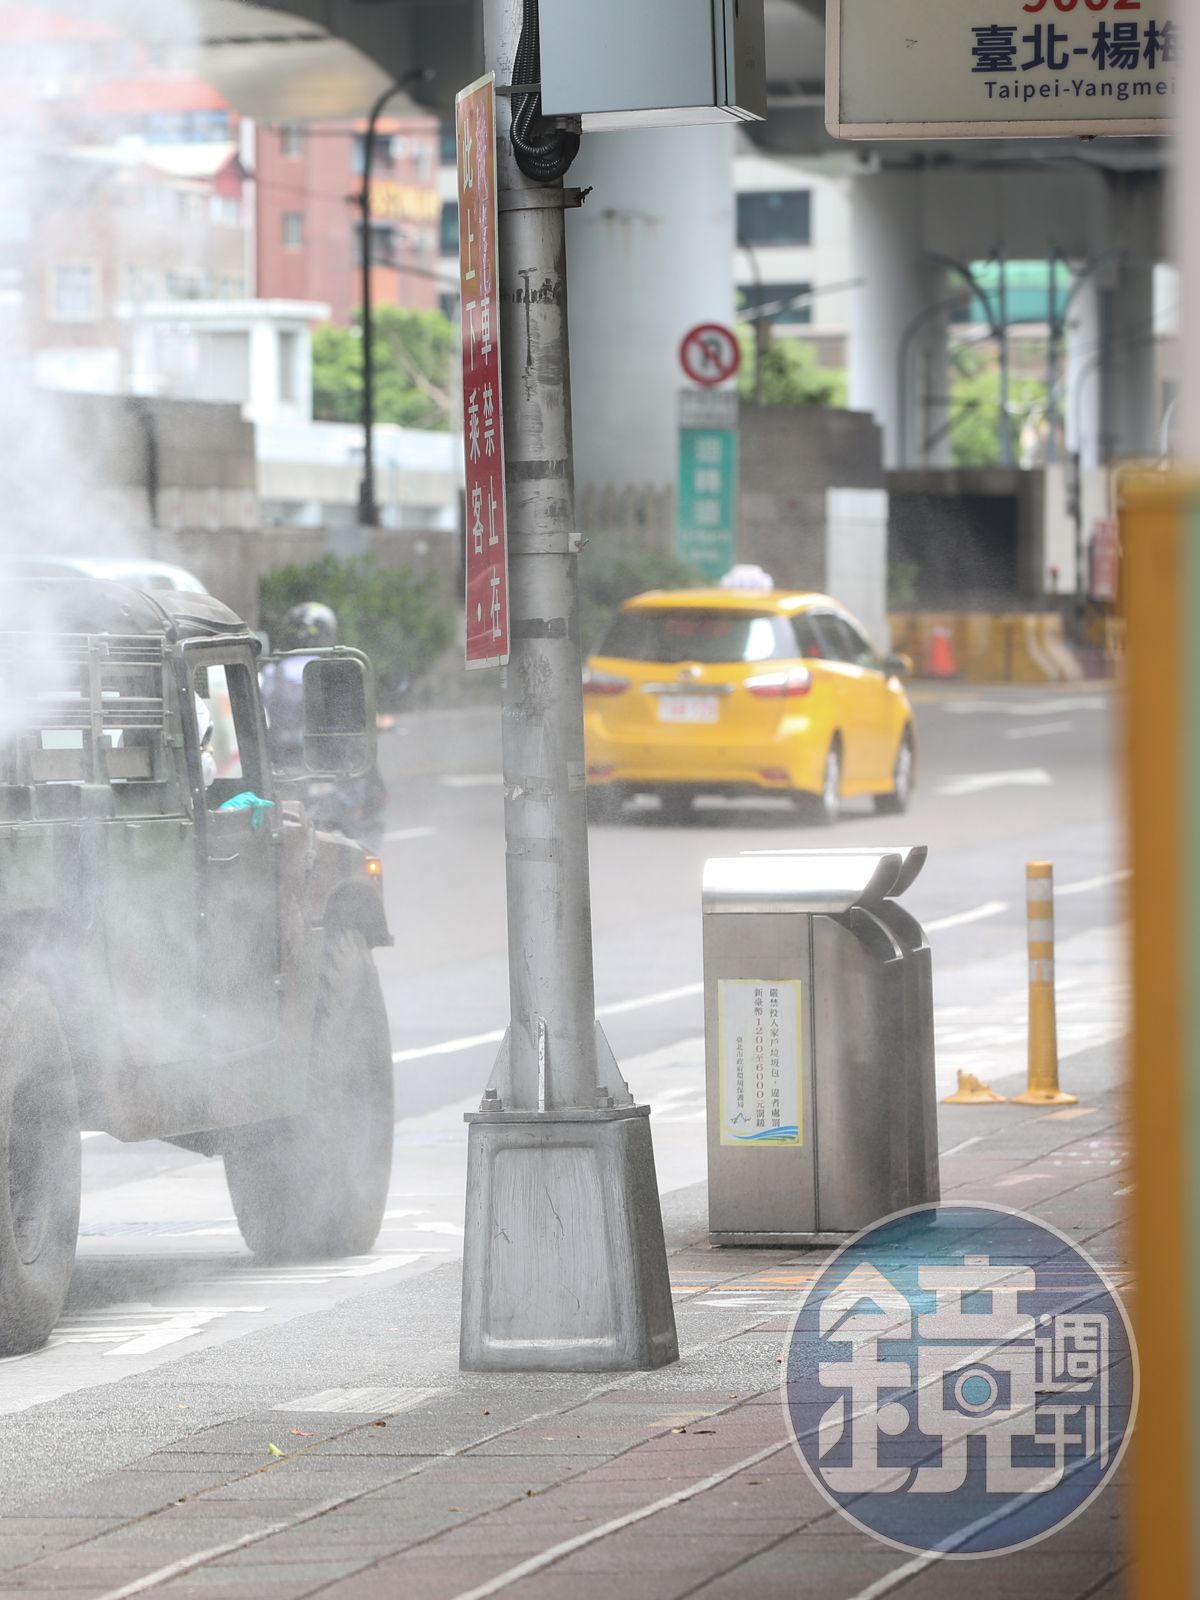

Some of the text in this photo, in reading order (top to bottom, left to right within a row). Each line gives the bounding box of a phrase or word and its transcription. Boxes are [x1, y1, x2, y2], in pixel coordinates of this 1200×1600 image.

[971, 20, 1185, 73] 臺北-楊梅
[984, 77, 1177, 102] Taipei-Yangmei
[475, 104, 502, 642] 車禁止在
